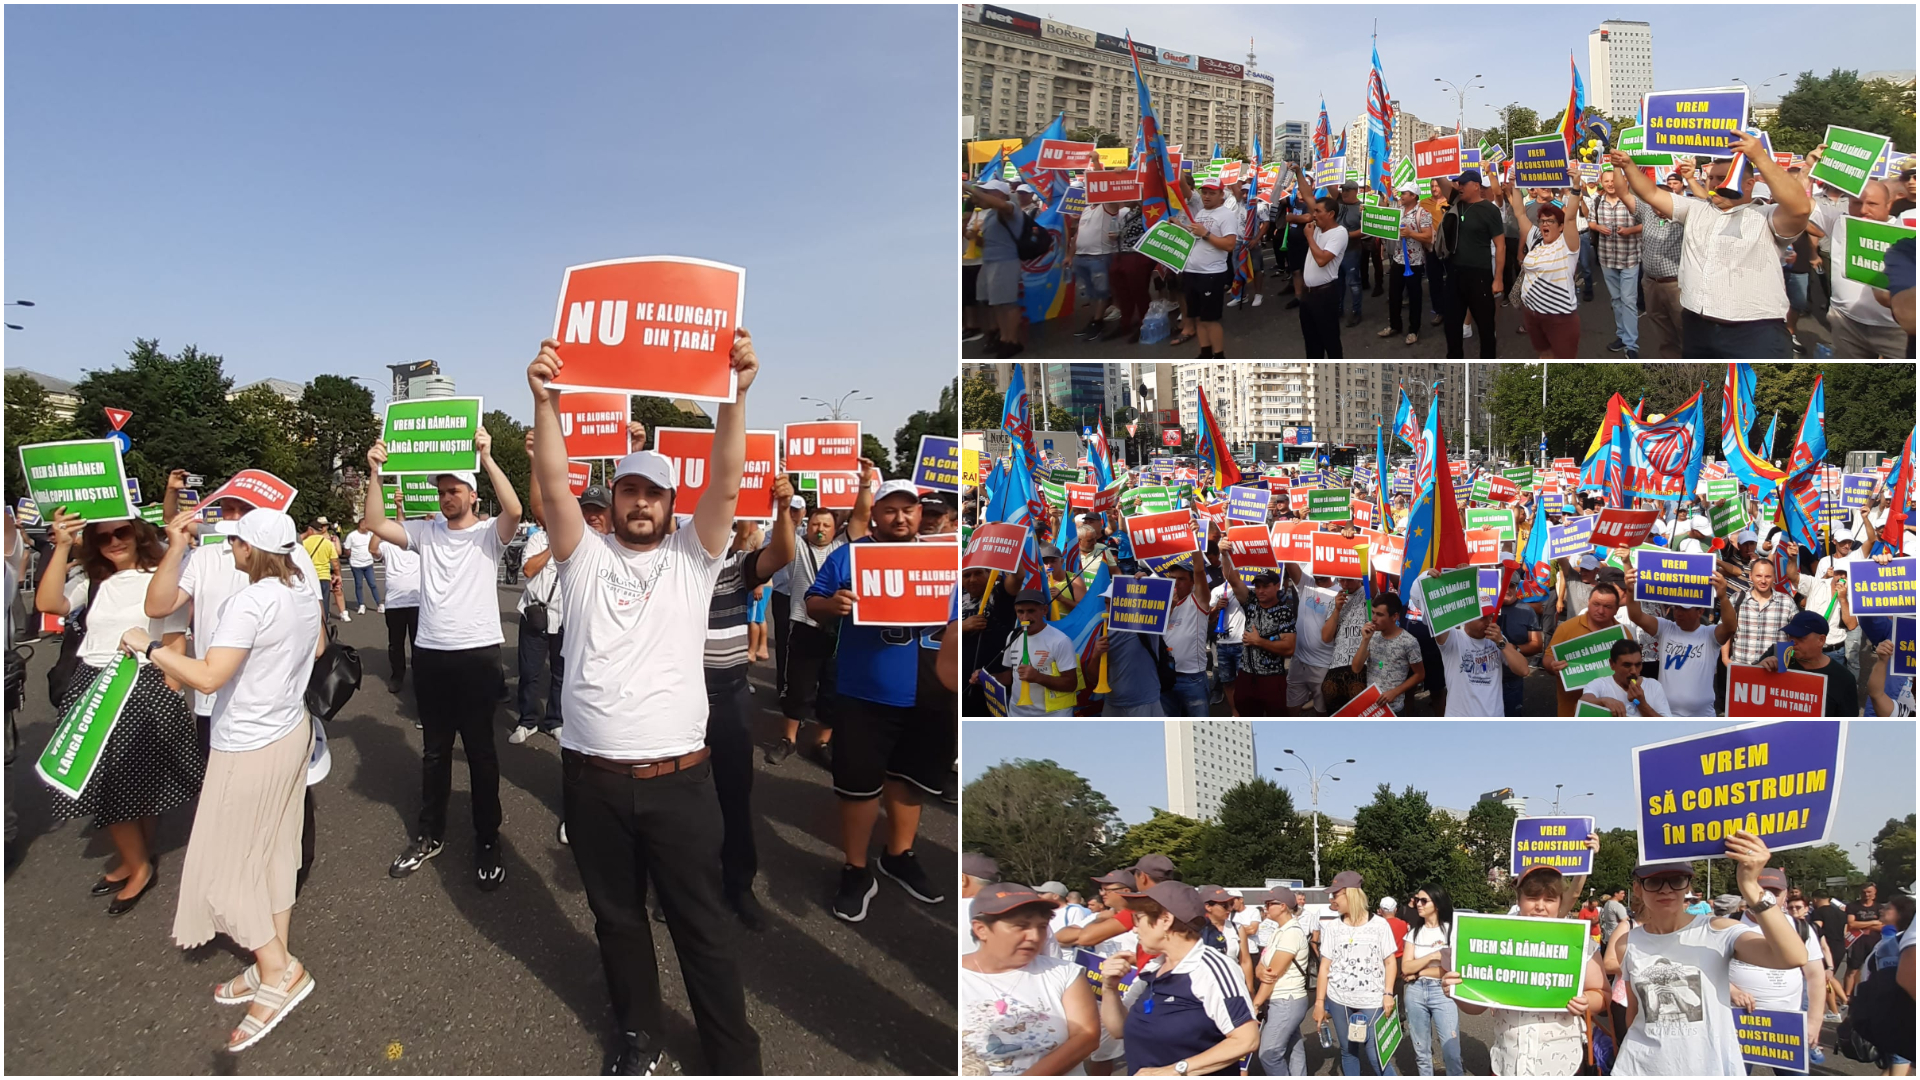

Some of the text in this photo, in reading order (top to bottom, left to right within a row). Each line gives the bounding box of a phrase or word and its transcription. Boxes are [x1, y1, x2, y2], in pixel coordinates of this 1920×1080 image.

[1047, 24, 1091, 42] BORSEC
[1676, 102, 1709, 112] VREM
[1650, 116, 1738, 130] SĂ CONSTRUIM
[1656, 132, 1728, 148] ÎN ROMÂNIA!
[1043, 148, 1063, 160] NU
[1418, 152, 1432, 166] NU
[1528, 149, 1546, 158] VREM
[1516, 160, 1564, 170] SĂ CONSTRUIM
[1520, 172, 1562, 182] ÎN ROMÂNIA!
[1090, 181, 1108, 193] NU
[565, 300, 727, 346] NU NE ALUNGAȚI
[644, 328, 716, 352] DIN ȚARĂ!
[394, 416, 467, 430] VREM SĂ RĂMÂNEM
[560, 412, 572, 436] U
[576, 413, 586, 422] NE
[582, 425, 594, 434] DIN
[387, 439, 412, 453] LÂNGĂ
[414, 441, 438, 452] COPIII
[790, 438, 816, 456] NU
[58, 461, 105, 476] RĂMÂNEM
[922, 456, 936, 467] SĂ
[740, 476, 762, 489] ARĂ!
[822, 478, 845, 494] NU
[1493, 484, 1502, 494] NU
[74, 486, 118, 503] NOȘTRI!
[1598, 521, 1622, 536] NU
[1134, 528, 1156, 546] NU
[1273, 533, 1290, 548] NU
[1468, 540, 1478, 552] NU
[1316, 546, 1335, 562] NU
[1662, 559, 1688, 570] VREM
[1878, 566, 1906, 577] VREM
[862, 569, 919, 597] NU NE
[1640, 570, 1710, 584] SĂ CONSTRUIM
[916, 585, 932, 596] DIN
[1126, 584, 1148, 594] VREM
[1646, 584, 1704, 598] ÎN ROMÂNIA!
[1855, 581, 1868, 592] SĂ
[1113, 598, 1166, 610] SĂ CONSTRUIM
[1862, 594, 1916, 607] ÎN ROMÂNI
[1120, 612, 1158, 624] ROMÂNIA!
[1581, 647, 1590, 656] SĂ
[1900, 640, 1915, 652] SĂ
[1734, 682, 1818, 705] NU NE ALUNGAȚI
[1774, 700, 1812, 714] DIN ȚARĂ!
[1700, 743, 1768, 776] VREM
[1649, 768, 1827, 816] SĂ CONSTRUIM
[1540, 826, 1566, 836] VREM
[1662, 808, 1810, 845] ÎN ROMÂNIA!
[1518, 840, 1530, 852] SĂ
[1522, 855, 1532, 866] ÎN
[1470, 938, 1569, 960] VREM SĂ RĂMÂNEM
[1462, 964, 1574, 990] LÂNGĂ COPIII NOȘTRI!
[1740, 1015, 1772, 1028] VREM
